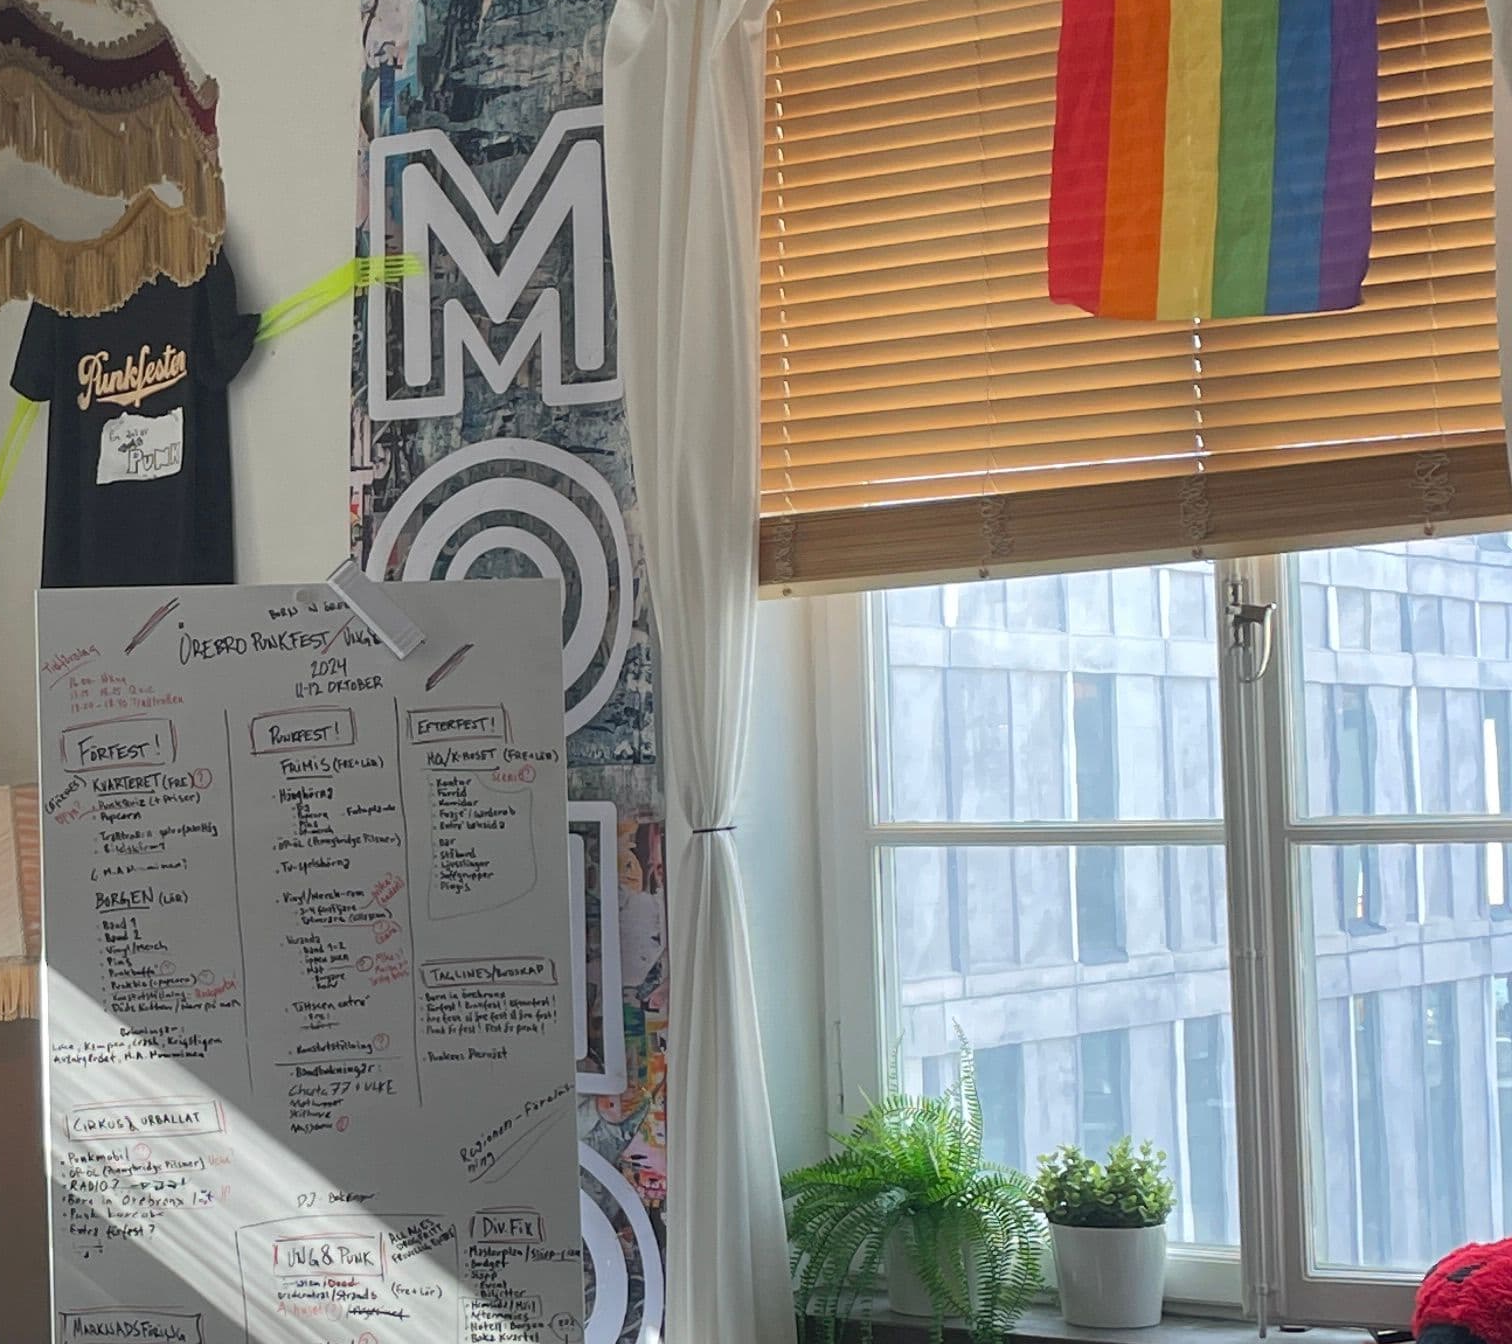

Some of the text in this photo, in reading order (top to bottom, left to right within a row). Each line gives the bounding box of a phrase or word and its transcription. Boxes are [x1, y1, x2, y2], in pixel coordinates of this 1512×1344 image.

[178, 621, 248, 666] ÖREBRO
[250, 629, 330, 653] PUNKFEST
[310, 656, 348, 678] 2024
[327, 675, 385, 694] OKTOBER
[268, 721, 340, 745] PUNKFEST!
[93, 771, 162, 793] KVARTERET
[95, 886, 154, 910] BORGEN
[72, 1116, 125, 1135] CIRKUS
[287, 1245, 320, 1269] UNG
[337, 1245, 376, 1267] PUNK
